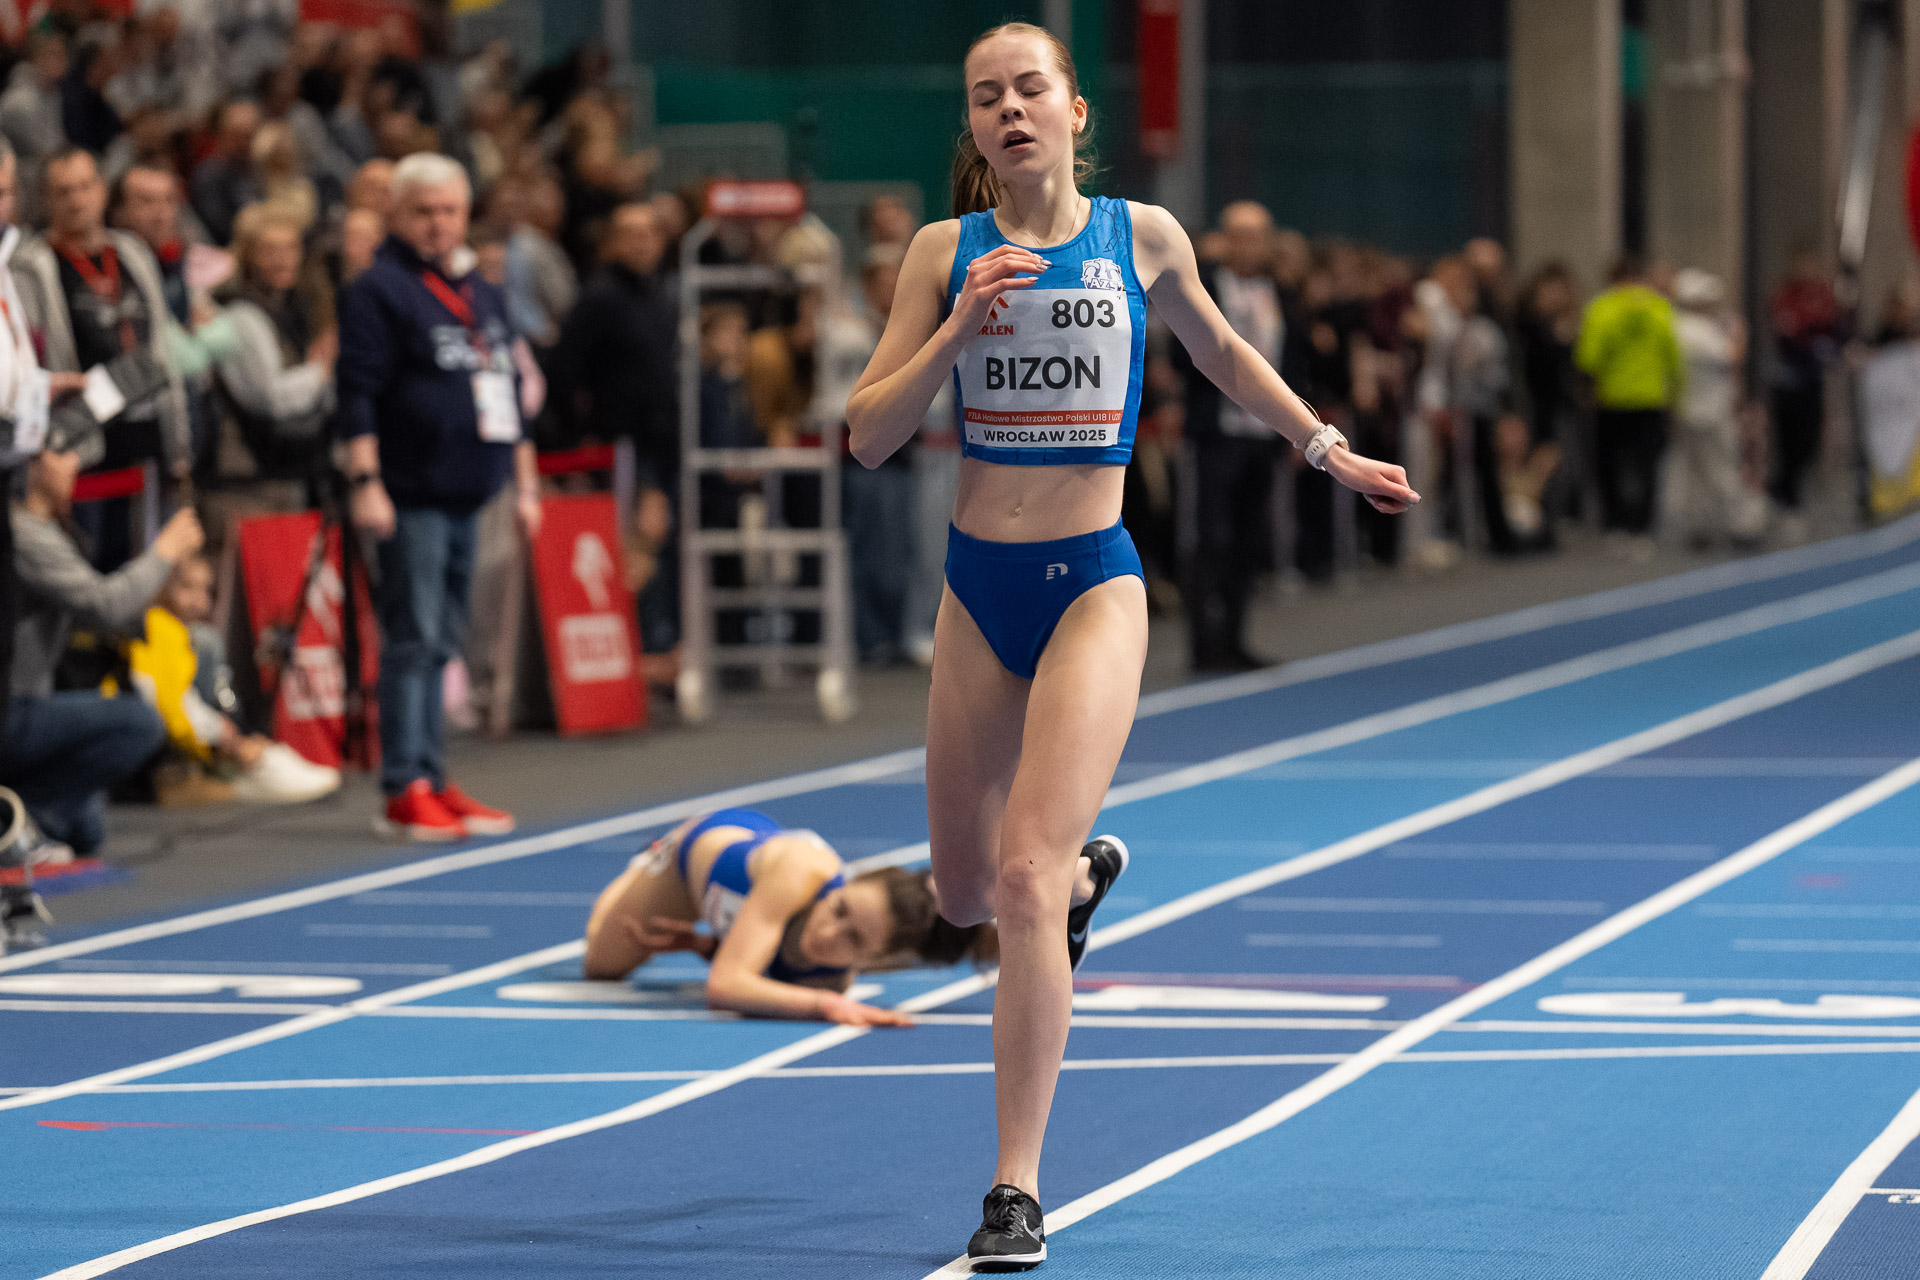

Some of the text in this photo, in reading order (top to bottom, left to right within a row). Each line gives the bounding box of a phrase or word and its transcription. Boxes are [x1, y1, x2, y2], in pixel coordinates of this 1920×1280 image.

[1051, 299, 1115, 328] 803
[976, 324, 1014, 336] RLEN
[986, 355, 1101, 390] BIZON
[1011, 414, 1064, 423] Mistrzostwa
[1065, 413, 1091, 422] Polski
[1092, 412, 1107, 421] U18
[983, 429, 1107, 442] WROCŁAW 2025
